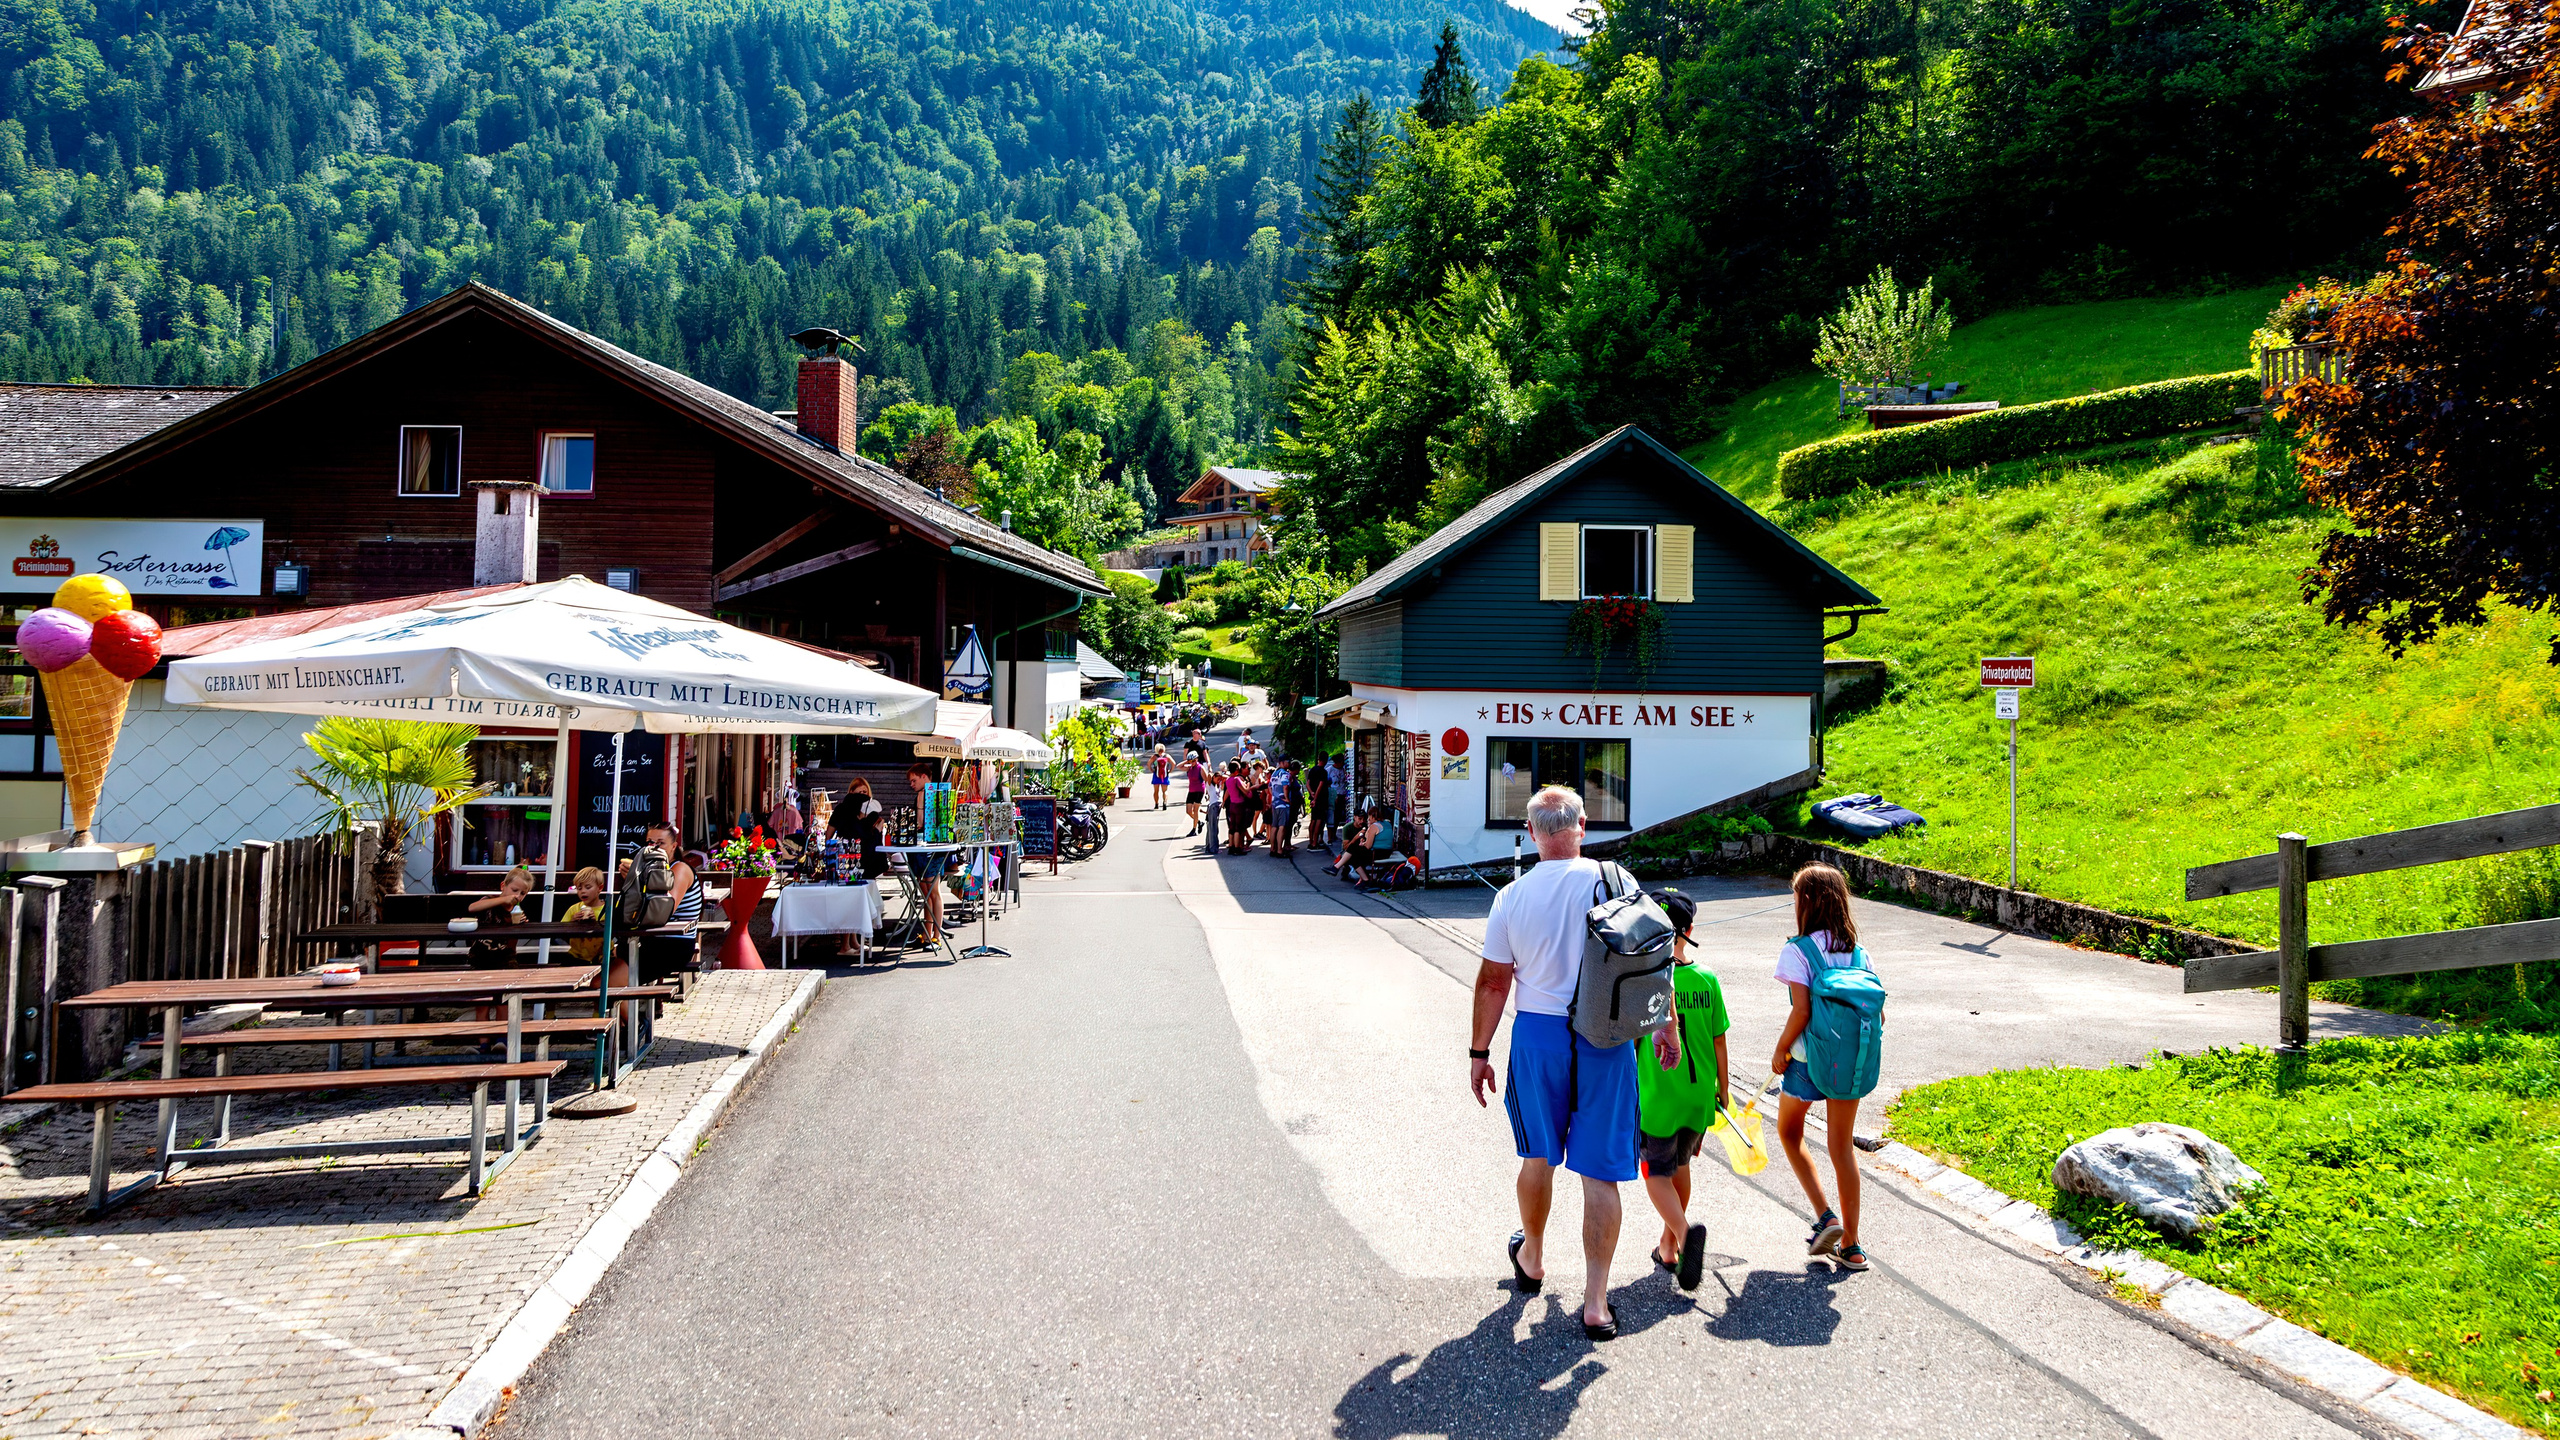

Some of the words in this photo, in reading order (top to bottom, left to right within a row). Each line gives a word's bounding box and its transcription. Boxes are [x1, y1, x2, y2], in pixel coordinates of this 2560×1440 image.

[18, 561, 69, 573] Reininghaus
[97, 551, 226, 574] Seeterrasse
[144, 574, 163, 587] Das
[205, 674, 260, 692] GEBRAUT
[266, 672, 290, 690] MIT
[294, 666, 405, 688] LEIDENSCHAFT.
[1982, 665, 2031, 683] Privatparkplatz
[545, 672, 660, 698] GEBRAUT
[670, 684, 713, 702] MIT
[722, 683, 882, 717] LEIDENSCHAFT.
[1495, 703, 1534, 724] EIS
[1558, 704, 1624, 726] CAFE
[1633, 705, 1677, 726] AM
[1690, 705, 1735, 727] SEE
[928, 744, 961, 755] HENKELL
[973, 749, 1012, 758] HENKELL
